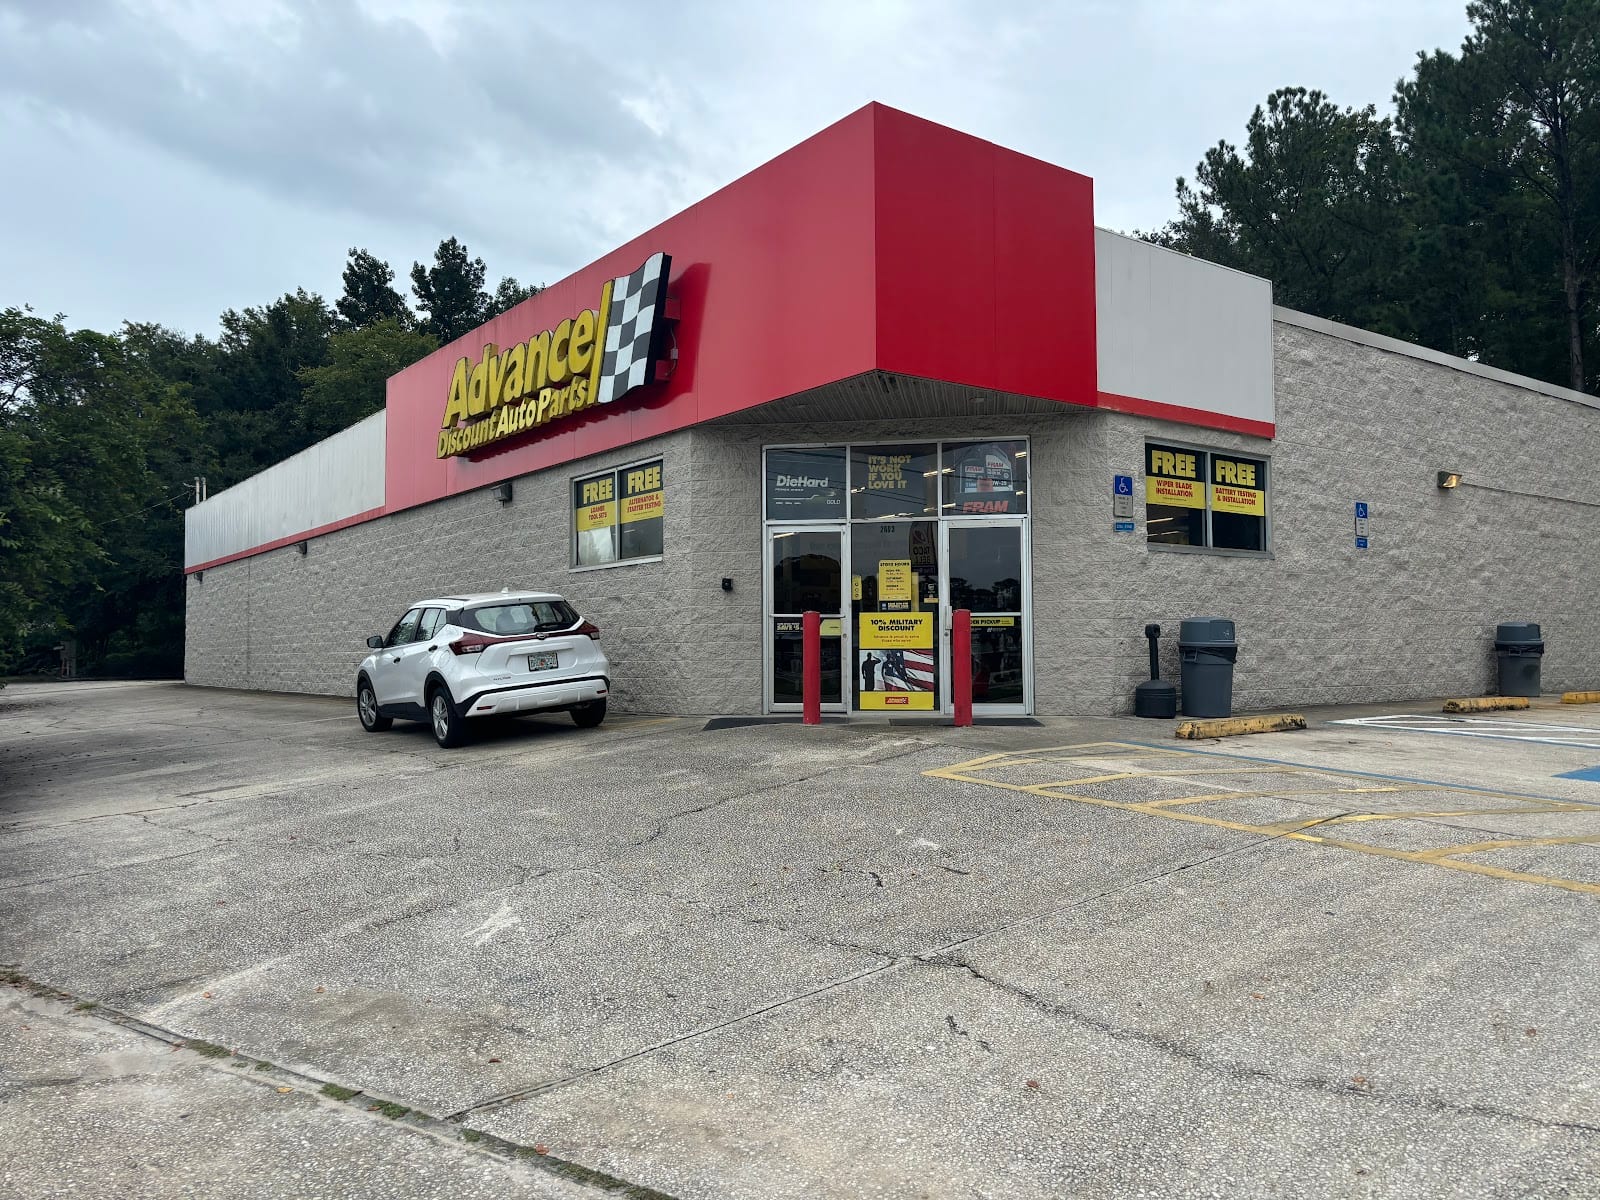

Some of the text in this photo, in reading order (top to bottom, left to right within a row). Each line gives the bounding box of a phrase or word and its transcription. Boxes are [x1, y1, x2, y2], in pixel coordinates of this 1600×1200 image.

[442, 308, 598, 428] Advance
[437, 411, 499, 458] Discount
[868, 455, 912, 464] IT'S NOT
[1151, 450, 1196, 478] FREE
[868, 464, 902, 473] WORK
[1215, 460, 1256, 487] FREE
[627, 466, 661, 495] FREE
[776, 475, 829, 488] DieHard
[868, 472, 902, 481] IF YOU
[868, 480, 908, 489] LOVE IT
[1156, 480, 1193, 490] WIPER BLADE
[583, 478, 613, 505] FREE
[1155, 487, 1194, 498] INSTALLATION
[1215, 487, 1257, 499] BATTERY TESTING
[644, 500, 662, 510] TESTING
[1222, 495, 1256, 506] INSTALLATION
[963, 501, 1009, 513] FRAM
